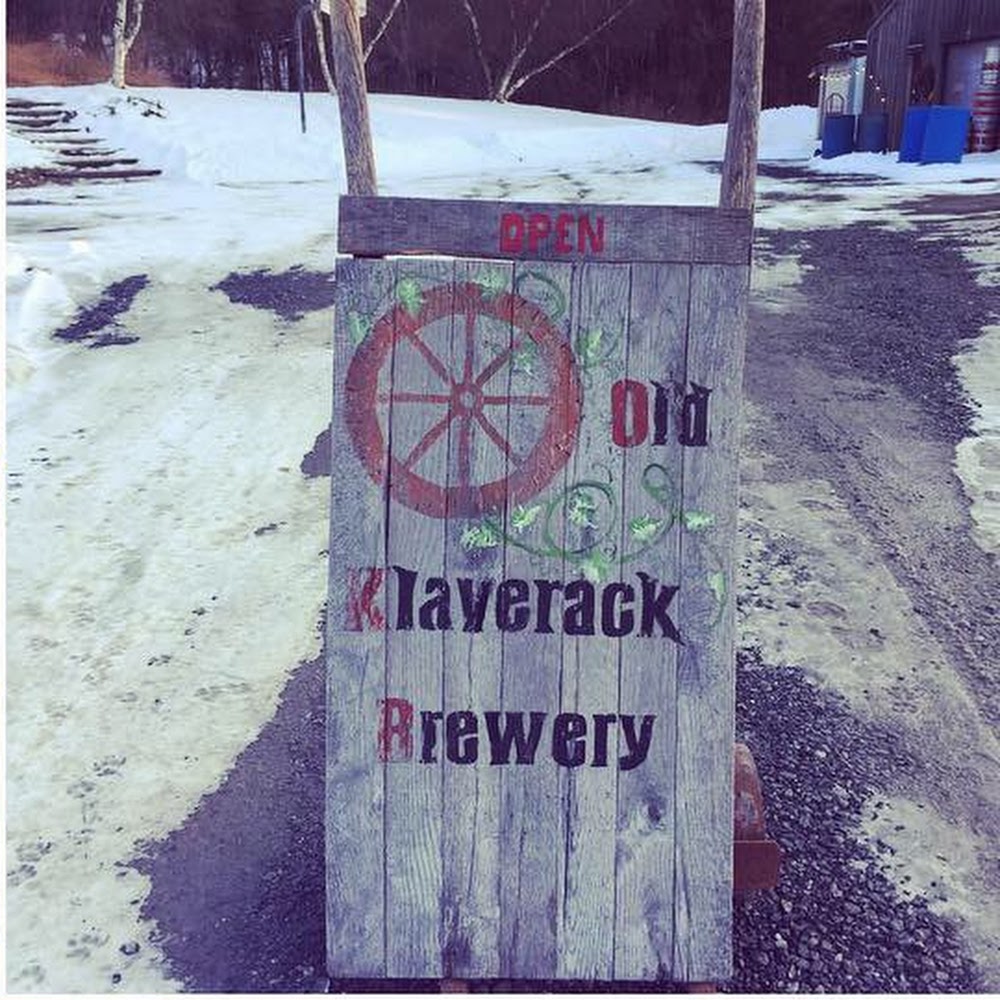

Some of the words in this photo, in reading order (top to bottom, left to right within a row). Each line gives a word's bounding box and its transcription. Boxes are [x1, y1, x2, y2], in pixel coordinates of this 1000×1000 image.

[499, 212, 606, 254] OPEN
[610, 377, 713, 447] Old
[345, 565, 686, 646] Klaverack
[377, 697, 658, 771] Brewery
